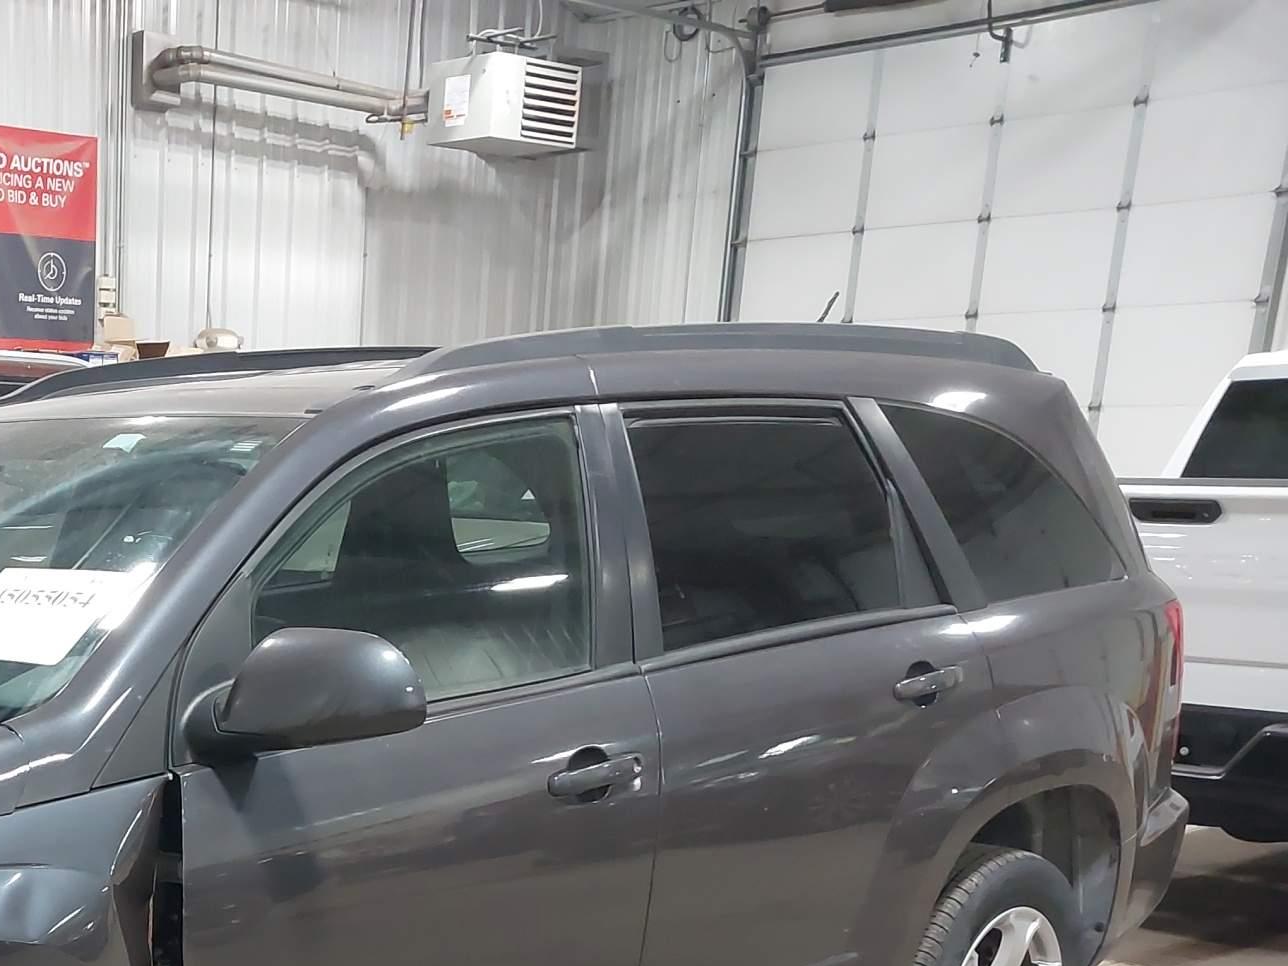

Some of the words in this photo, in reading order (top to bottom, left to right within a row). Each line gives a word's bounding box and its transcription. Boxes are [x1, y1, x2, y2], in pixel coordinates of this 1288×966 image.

[34, 174, 44, 188] A
[46, 174, 74, 192] NEW
[7, 188, 27, 204] BID
[28, 190, 39, 205] &
[41, 192, 67, 208] BUY
[18, 292, 55, 304] Real-Time
[55, 295, 82, 307] Updates
